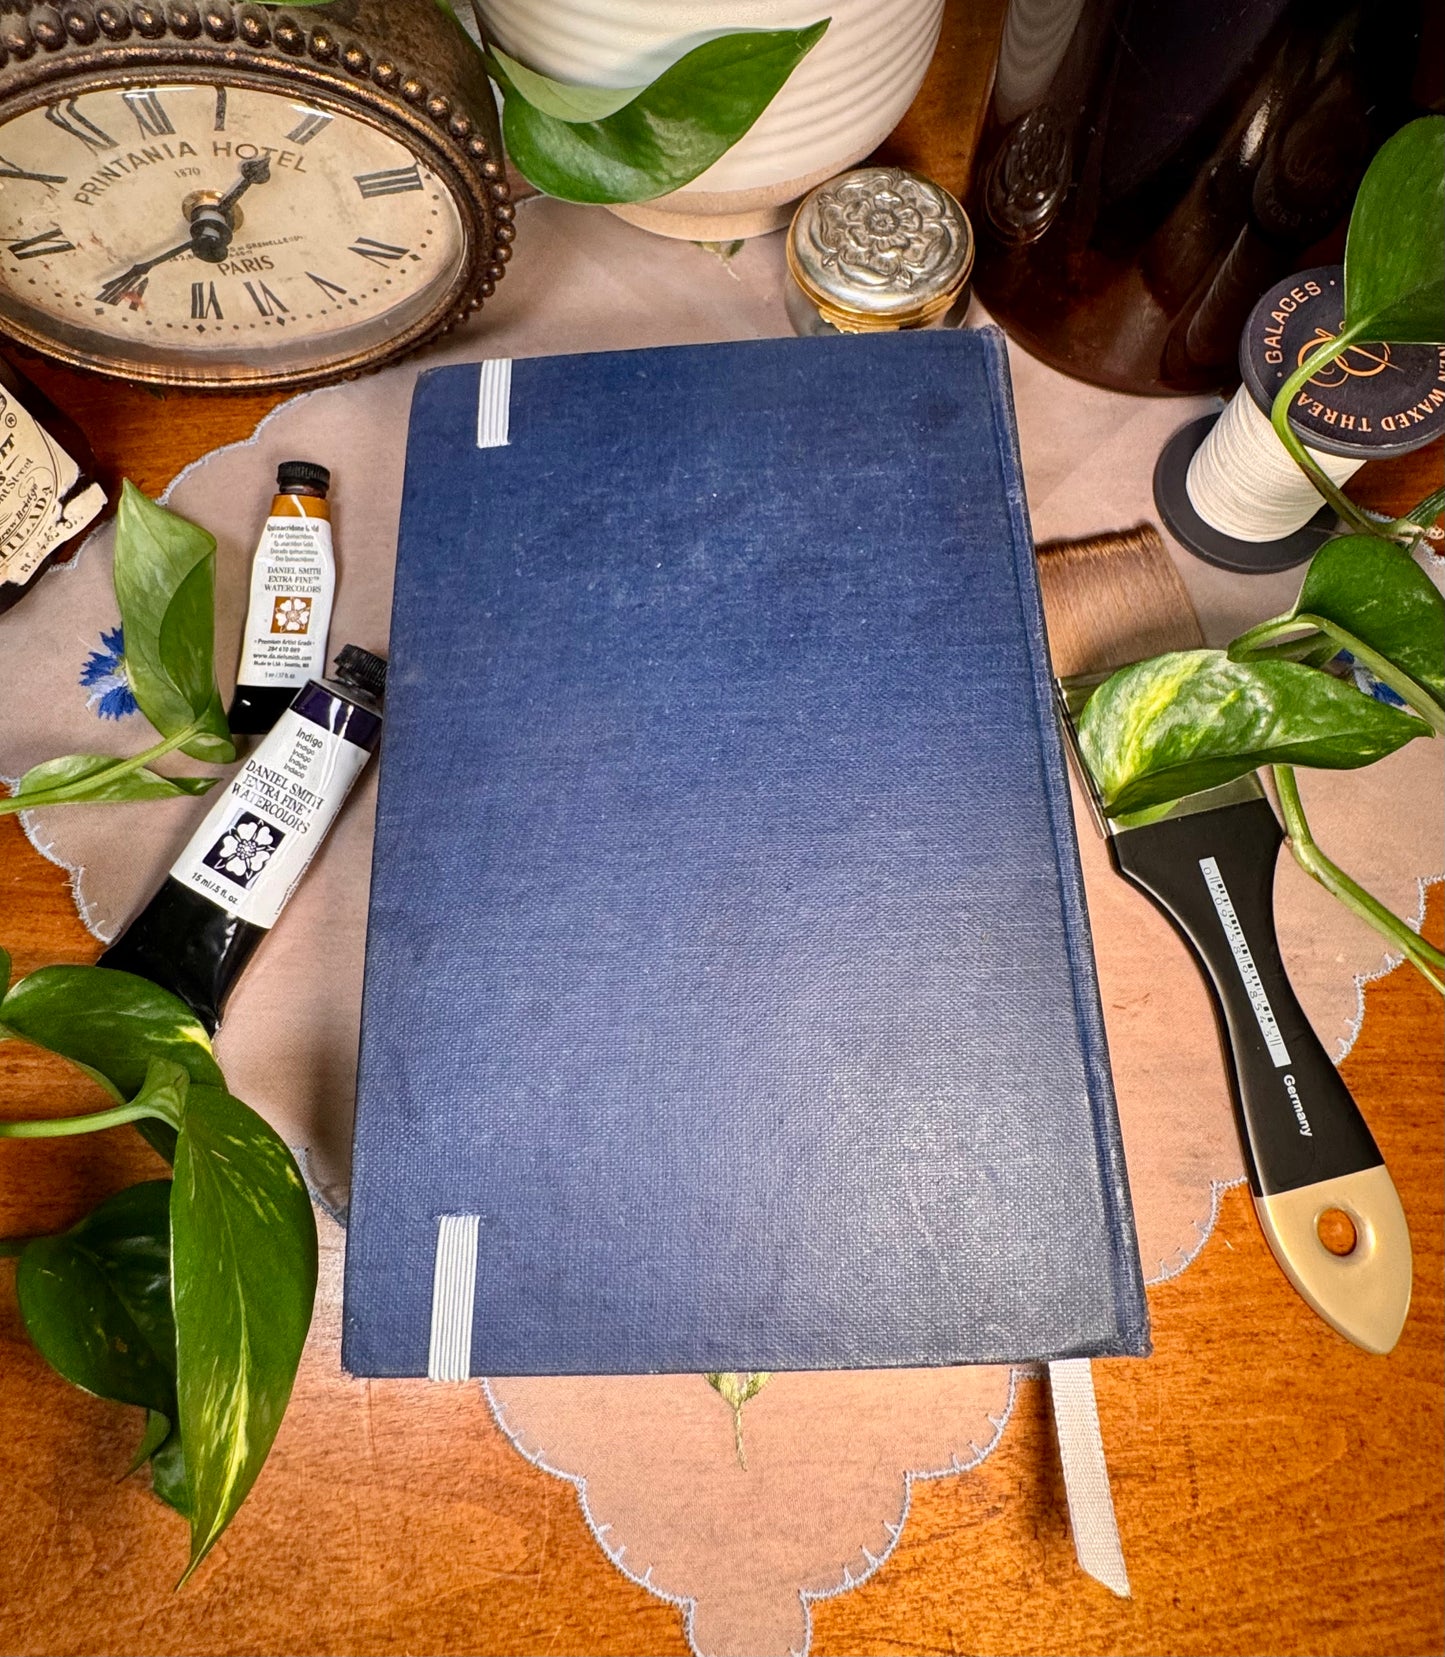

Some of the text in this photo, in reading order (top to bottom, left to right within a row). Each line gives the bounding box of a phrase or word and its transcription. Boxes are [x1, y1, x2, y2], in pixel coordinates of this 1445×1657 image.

[74, 140, 308, 206] PRINTANIA HOTEL
[174, 167, 201, 179] 1870
[353, 161, 424, 200] III
[217, 255, 275, 276] PARIS
[1264, 281, 1321, 364] GALACES
[1296, 391, 1372, 432] THREA
[1380, 387, 1445, 433] WAXED
[6, 457, 34, 490] Street
[267, 567, 296, 575] DANIEL
[264, 584, 321, 594] WATERCOLORS
[296, 727, 323, 749] Indigo
[296, 741, 315, 756] Indigo
[292, 749, 311, 763] Indigo
[242, 773, 280, 802] EXTRA
[245, 759, 325, 810] DANIEL SMITH
[232, 782, 311, 834] WATERCOLORS
[192, 872, 202, 882] 15
[1283, 1074, 1313, 1137] Germany
